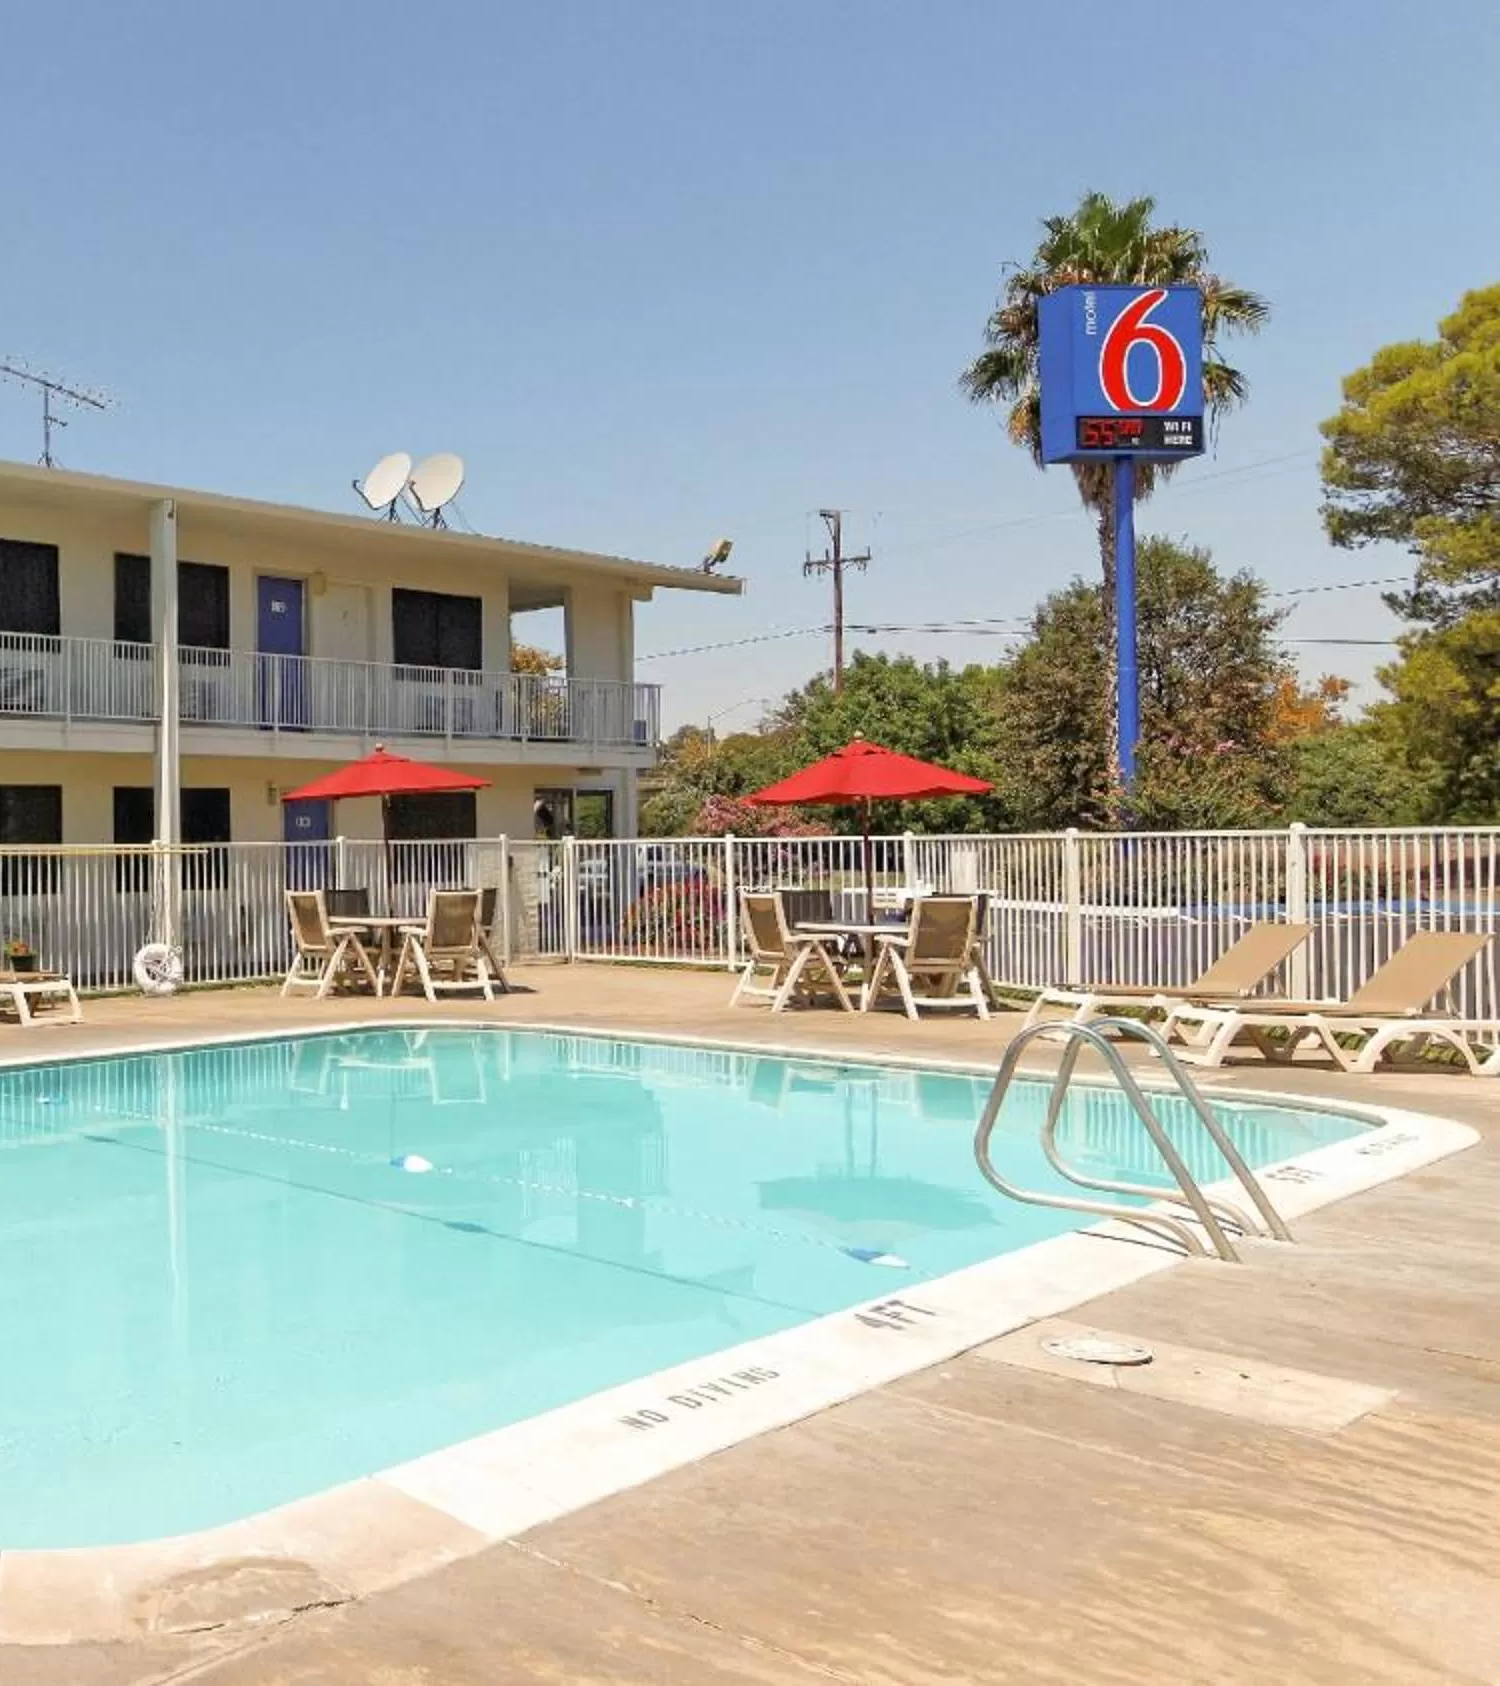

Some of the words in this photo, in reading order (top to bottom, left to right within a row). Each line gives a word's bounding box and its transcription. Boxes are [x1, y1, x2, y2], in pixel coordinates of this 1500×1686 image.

[1099, 288, 1187, 412] 6
[618, 1408, 669, 1431] NO
[666, 1366, 781, 1410] DIVING
